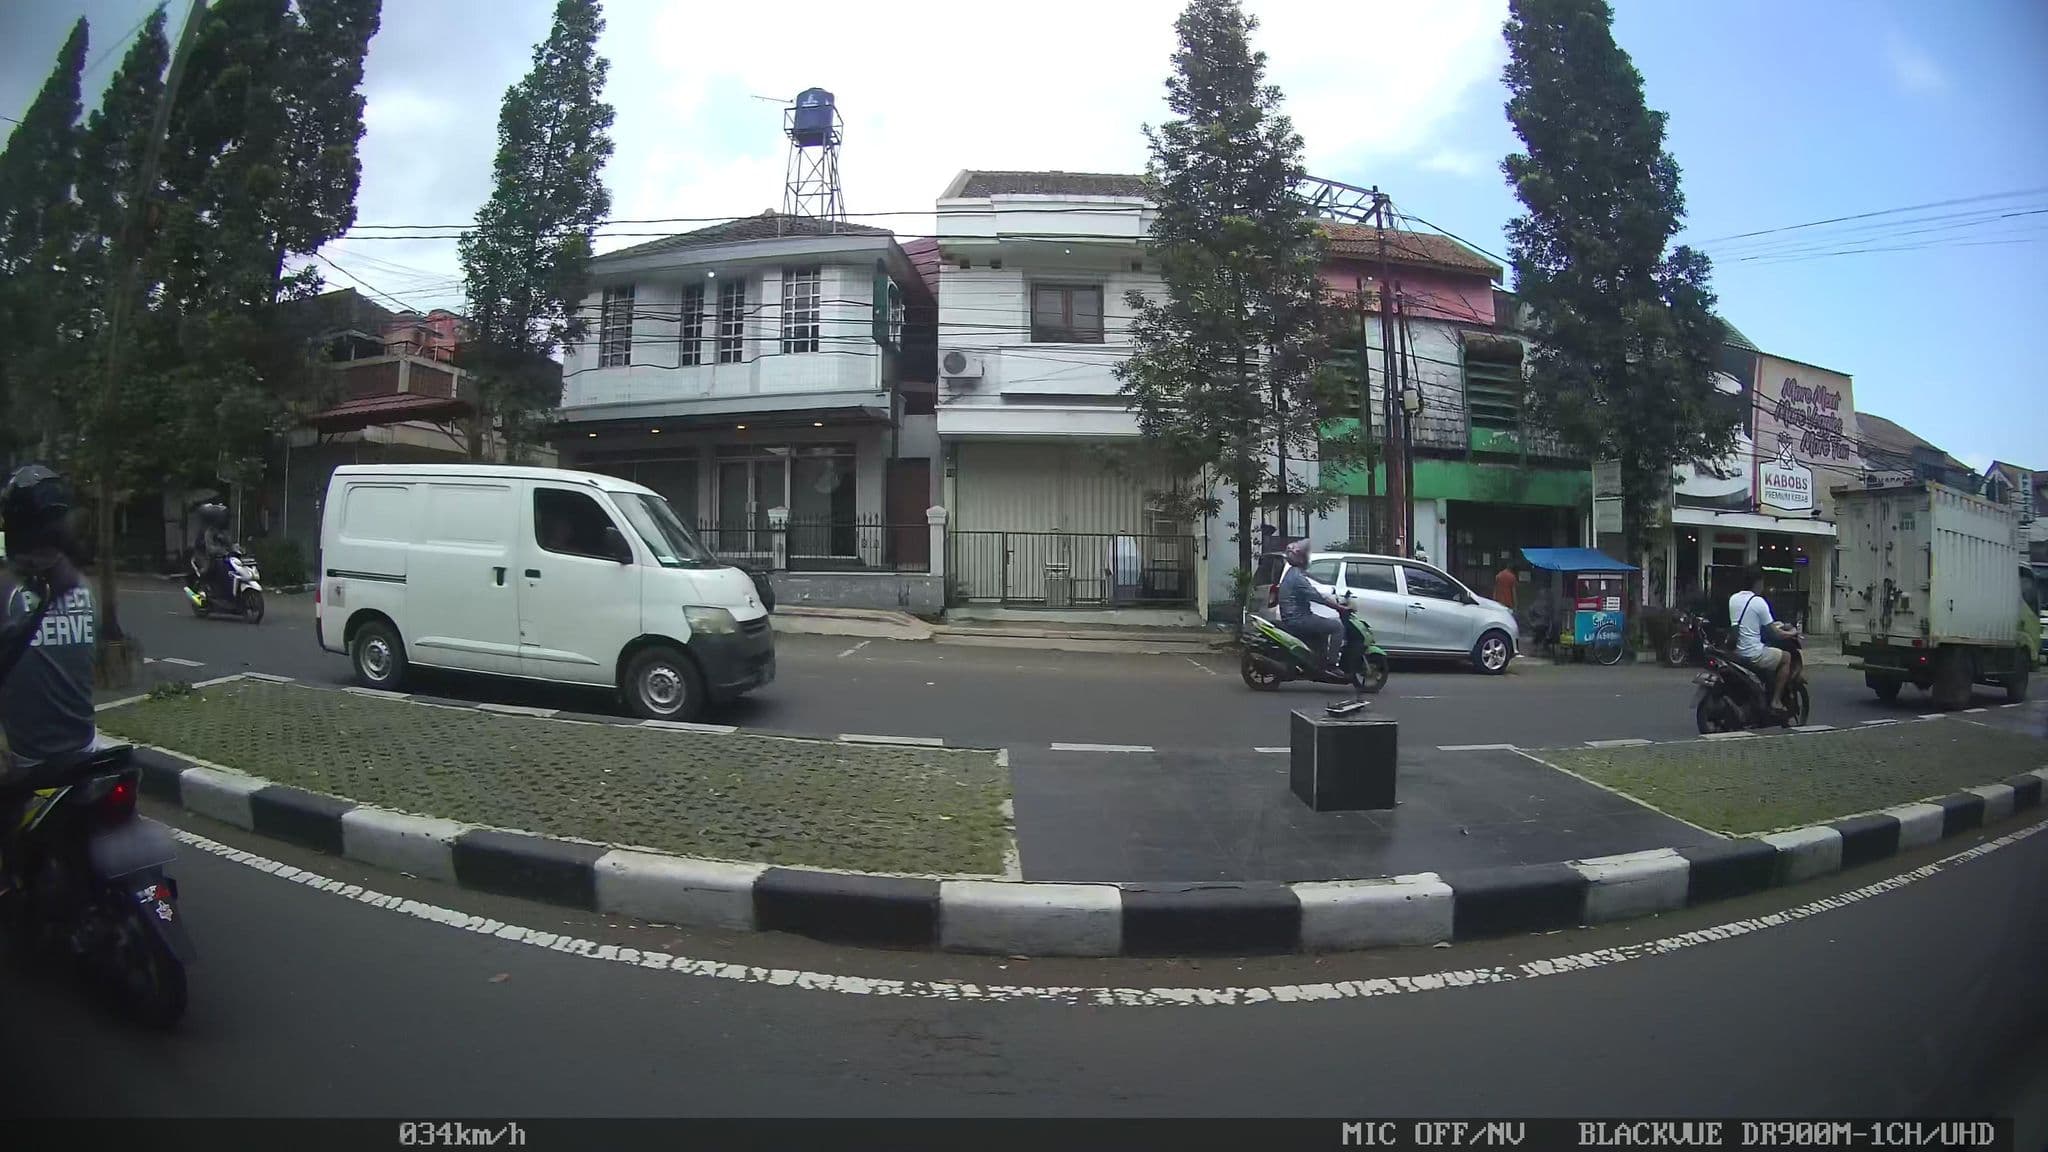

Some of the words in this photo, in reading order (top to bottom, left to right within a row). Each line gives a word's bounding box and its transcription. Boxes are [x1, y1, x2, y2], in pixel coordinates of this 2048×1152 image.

[1800, 431, 1831, 459] More
[1765, 473, 1808, 490] KABOBS
[1765, 490, 1791, 501] PREMIUM
[30, 615, 94, 647] SERVE
